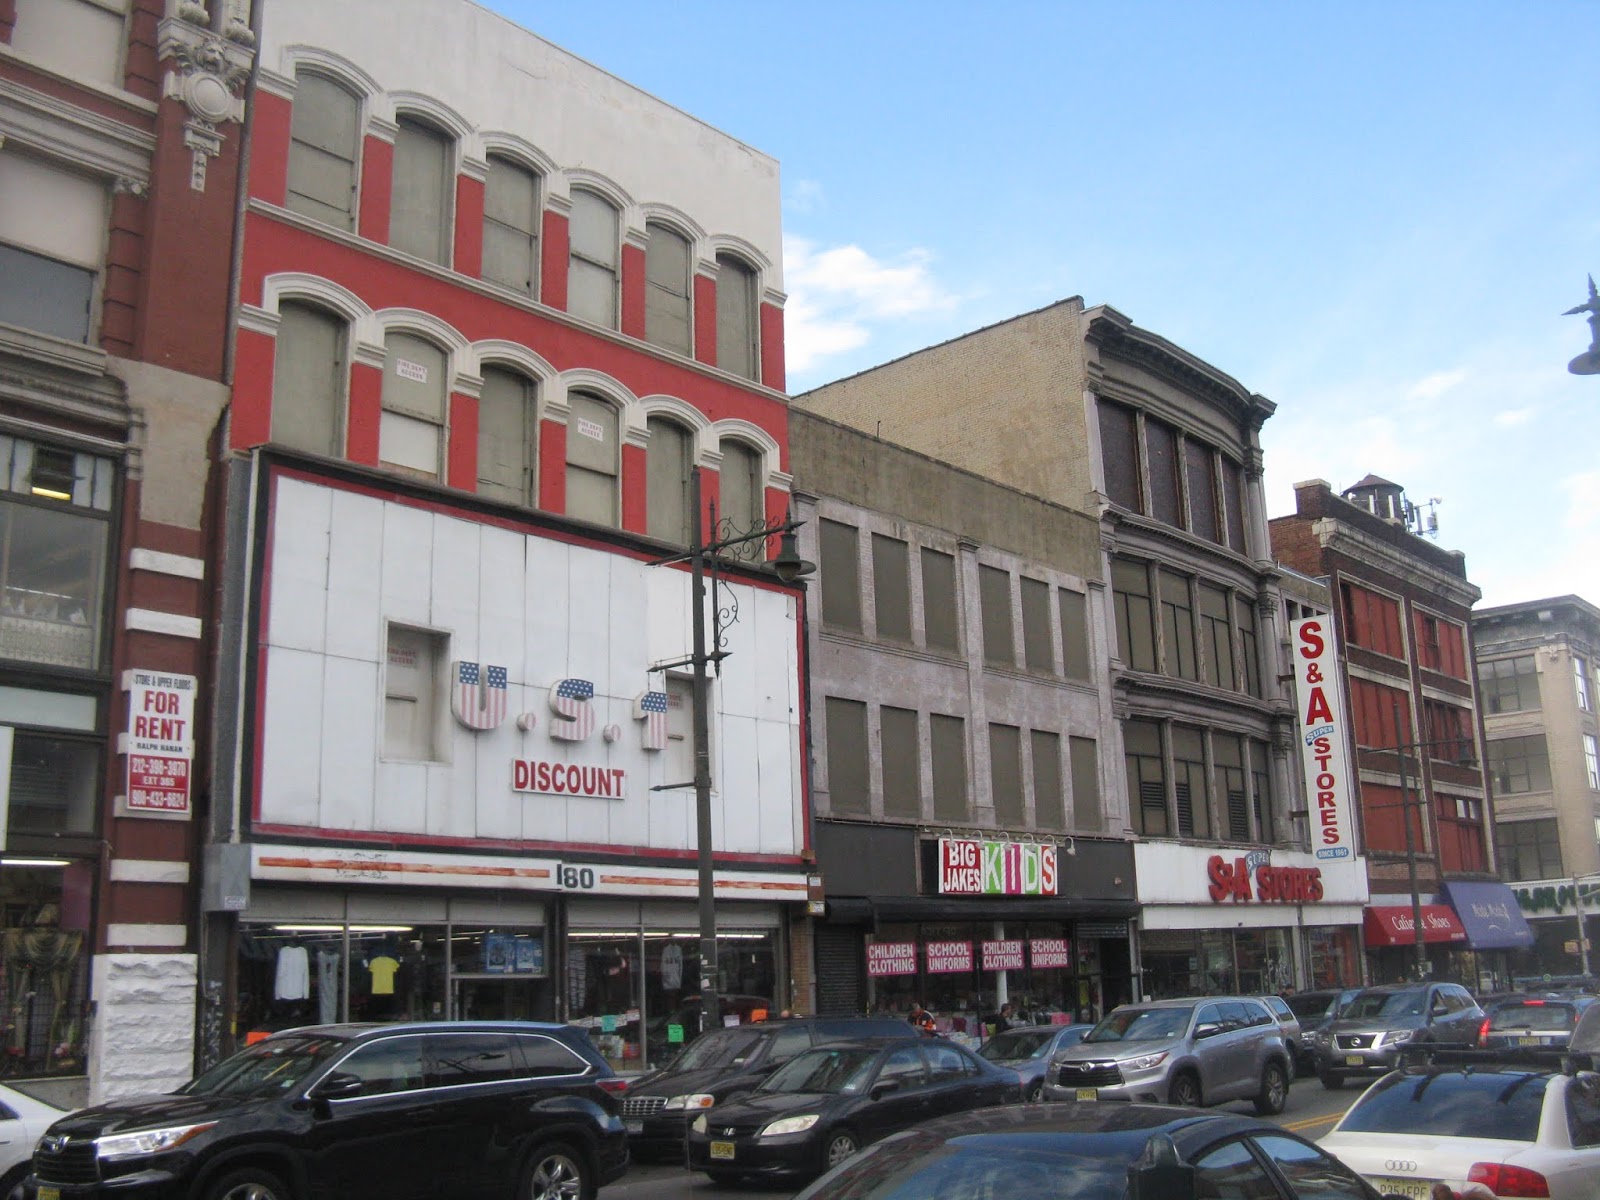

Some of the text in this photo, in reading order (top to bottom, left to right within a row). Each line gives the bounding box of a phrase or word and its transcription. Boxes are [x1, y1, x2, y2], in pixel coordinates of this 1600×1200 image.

[135, 674, 191, 691] STORE & UPPER FLOORS
[144, 690, 180, 715] FOR
[135, 716, 186, 742] RENT
[1306, 725, 1334, 744] SUPER
[137, 743, 158, 751] RALPH
[143, 776, 157, 785] EXT
[514, 759, 625, 797] DISCOUNT
[1314, 737, 1340, 844] STORES
[949, 843, 976, 866] BIG
[1318, 849, 1334, 858] SINCE
[985, 845, 1055, 891] KIDS
[944, 867, 980, 892] JAKES
[1256, 866, 1324, 901] STORES
[1426, 912, 1451, 929] Shoes
[868, 944, 914, 959] CHILDREN
[928, 942, 970, 957] SCHOOL
[982, 940, 1022, 954] CHILDREN
[1031, 939, 1067, 953] SCHOOL
[868, 958, 915, 974] CLOTHING
[928, 956, 971, 971] UNIFORMS
[983, 954, 1023, 968] CLOTHING
[1031, 952, 1068, 966] UNIFORMS
